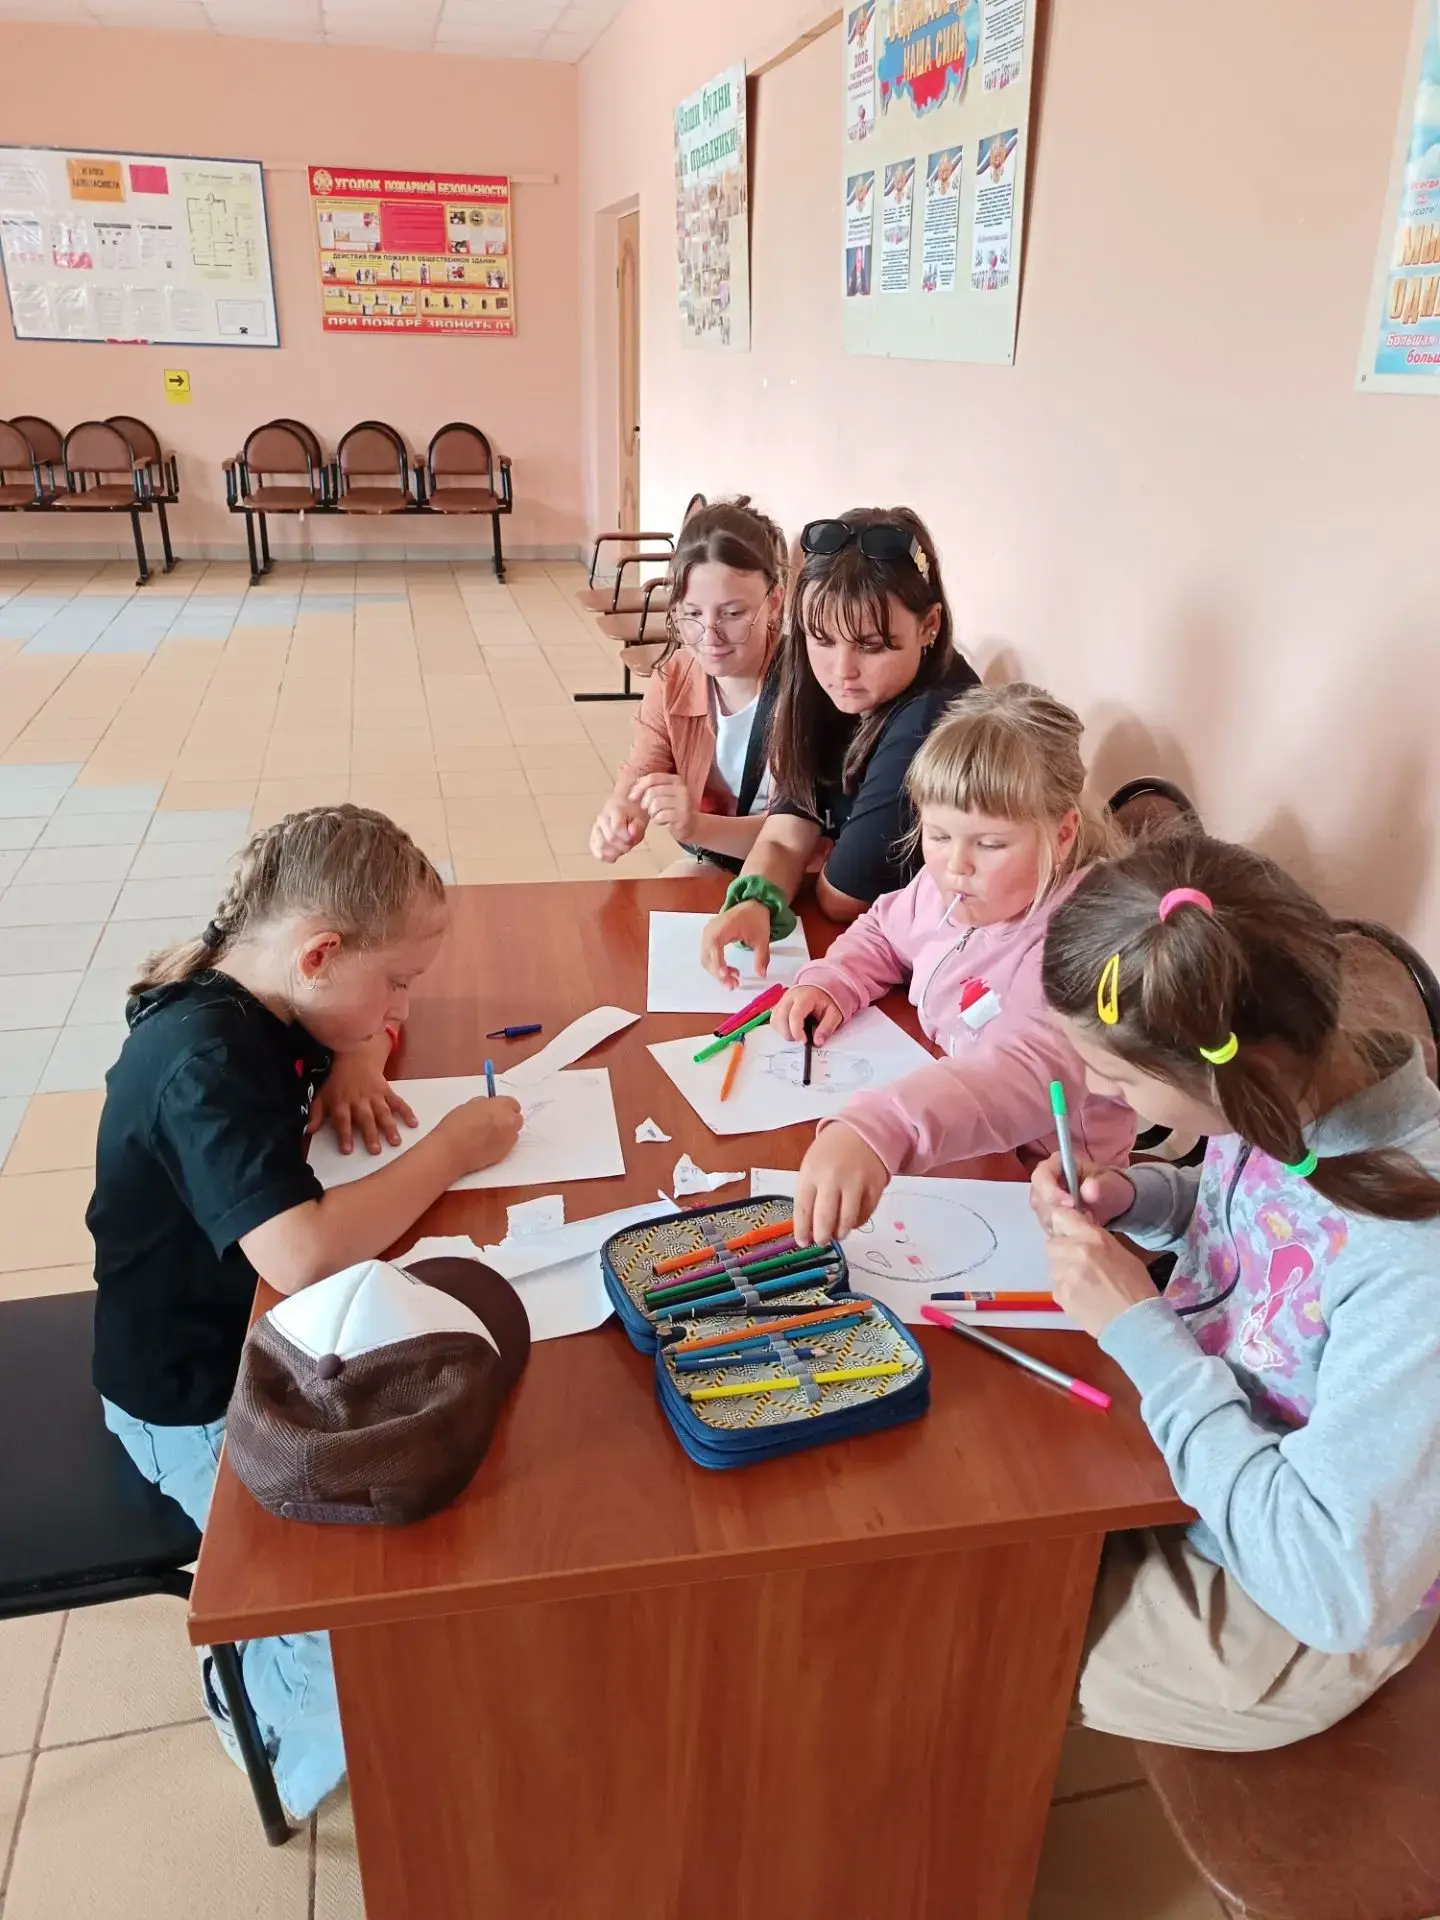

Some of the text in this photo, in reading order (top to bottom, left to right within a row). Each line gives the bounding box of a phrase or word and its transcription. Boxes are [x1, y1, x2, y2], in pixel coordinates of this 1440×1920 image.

[904, 36, 931, 81] НАША
[936, 23, 965, 68] СИЛА
[703, 83, 731, 127] будни
[690, 127, 737, 178] праздники
[334, 178, 508, 198] УГОЛОК ПОЖАРНОЙ БЕЗОПАСНОСТИ
[327, 317, 510, 330] ПРИ ПОЖАРЕ ЗВОНИТЬ 01
[1386, 332, 1434, 346] Большая
